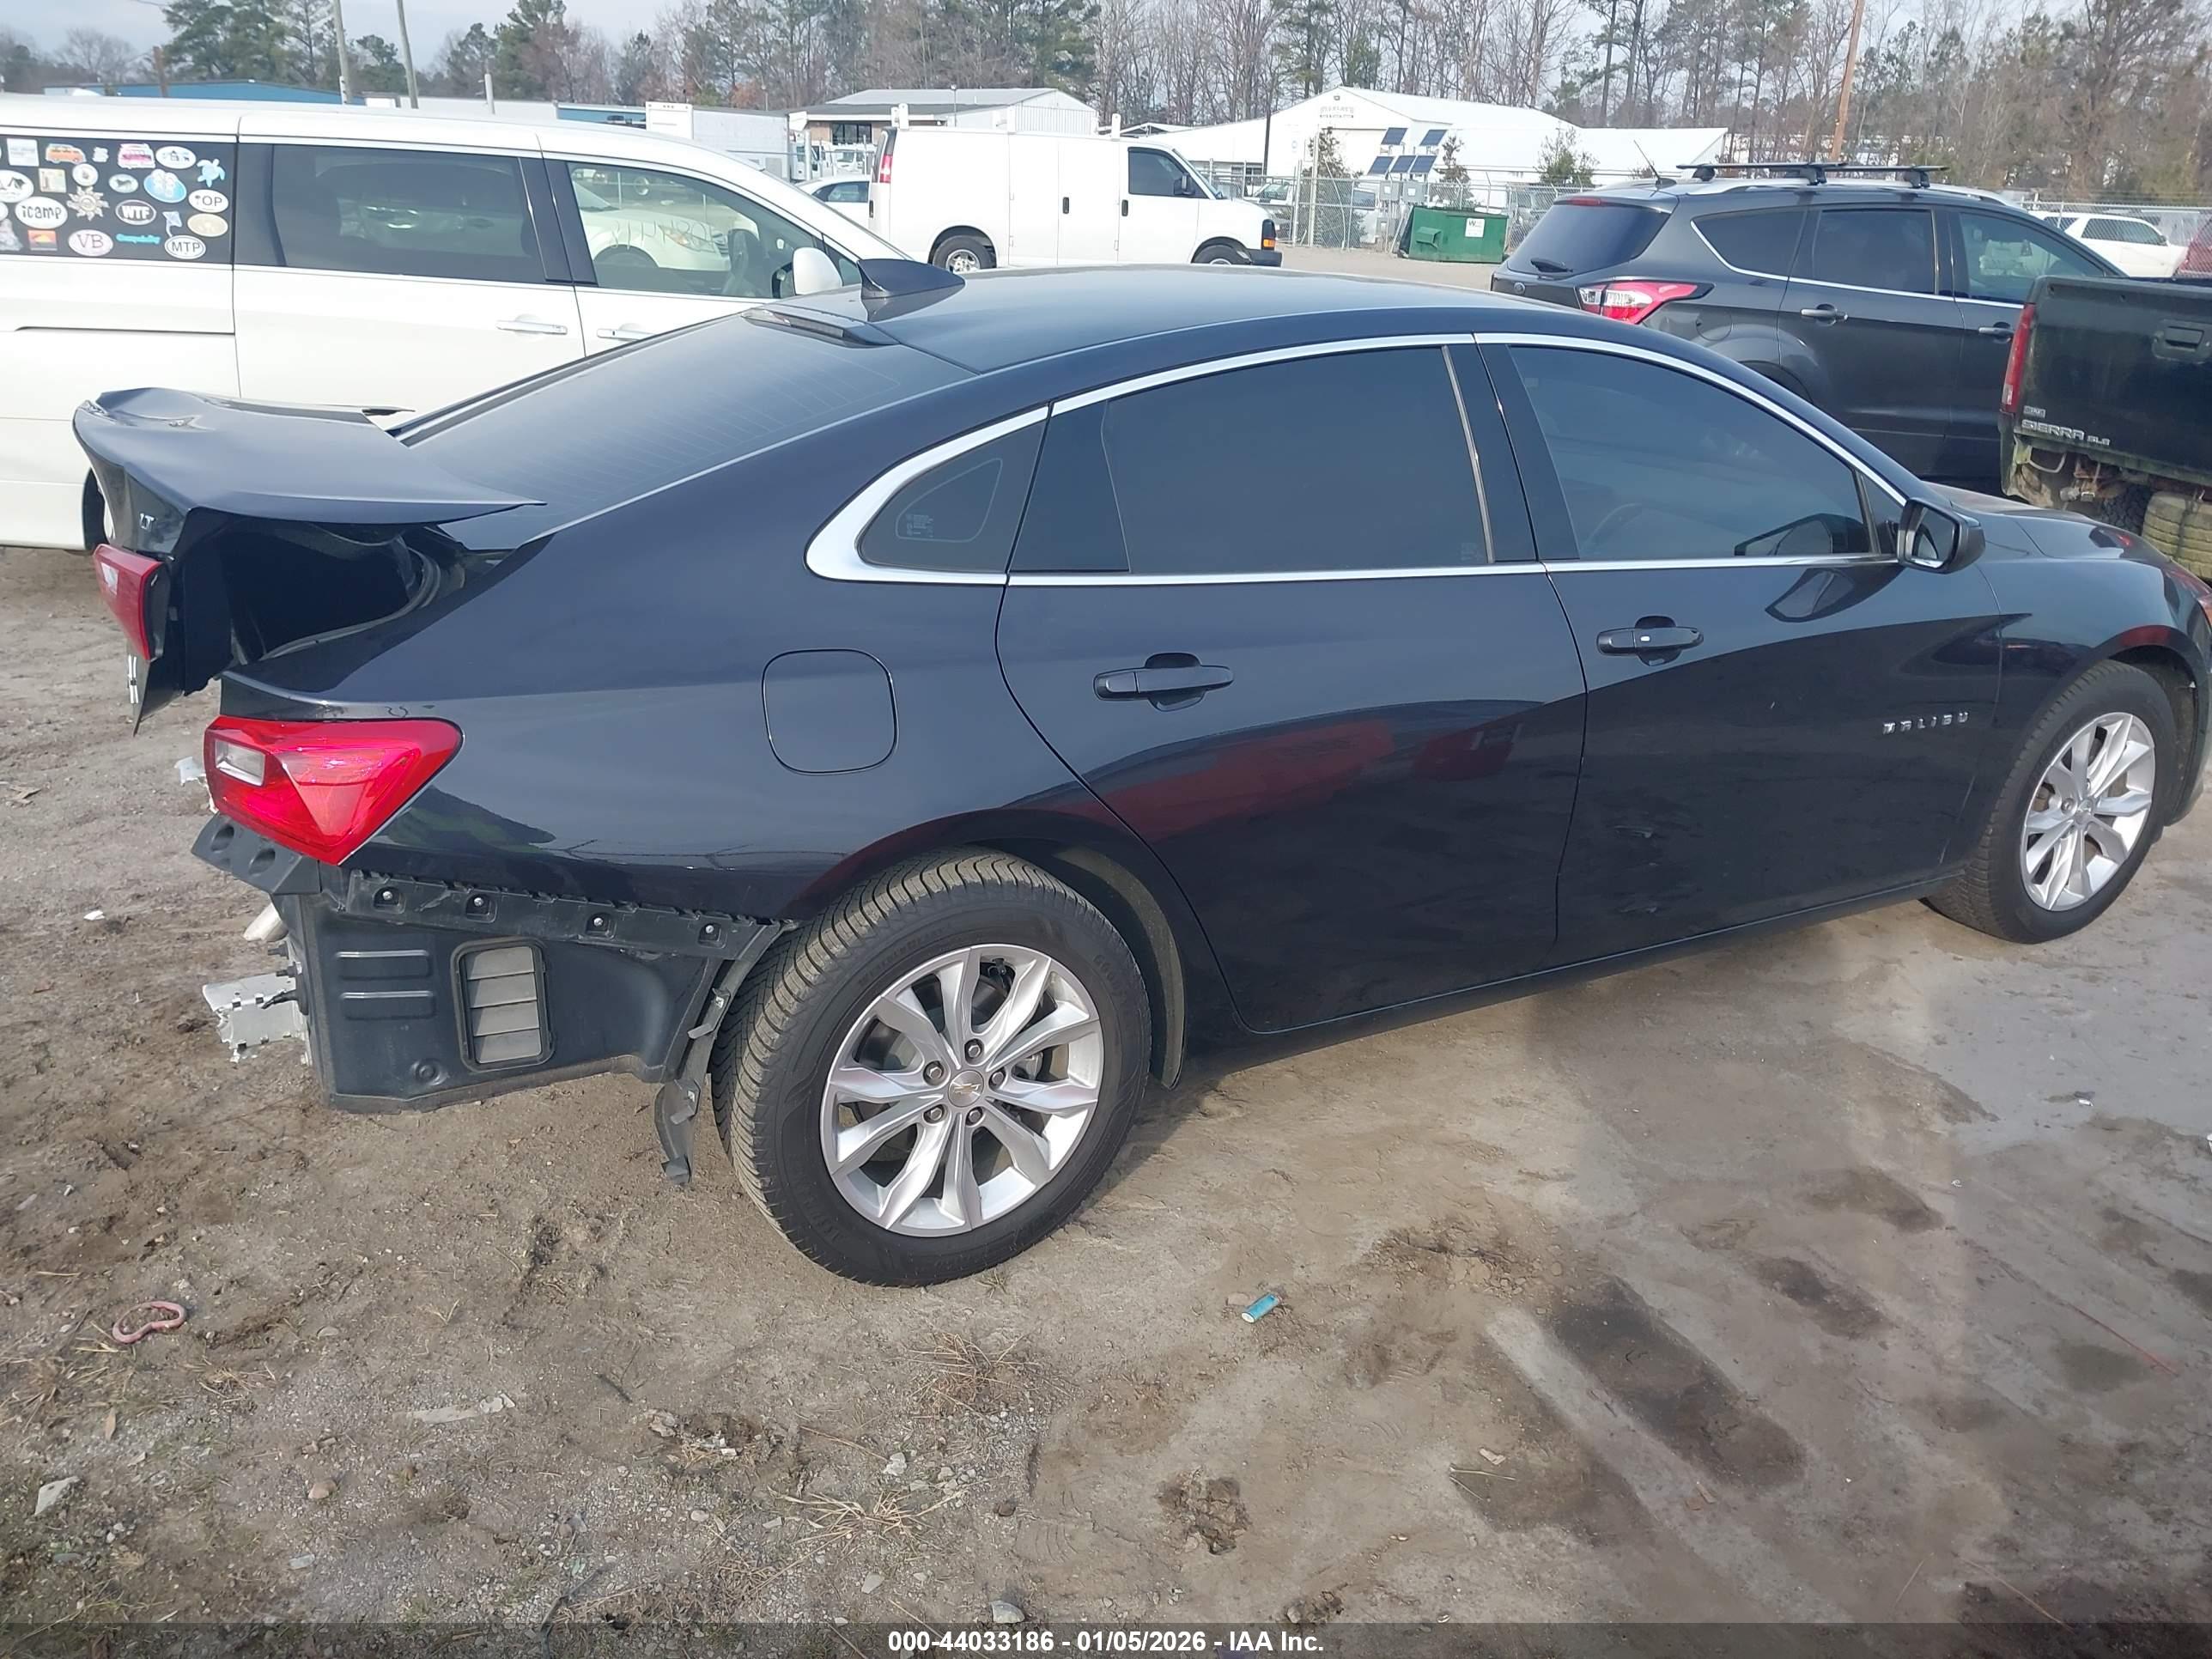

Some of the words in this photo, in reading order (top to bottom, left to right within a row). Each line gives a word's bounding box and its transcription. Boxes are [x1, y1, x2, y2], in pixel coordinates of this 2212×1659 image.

[21, 205, 62, 219] icamp
[122, 205, 149, 219] WTF
[77, 234, 104, 248] VB
[172, 241, 201, 252] MTP
[2022, 419, 2085, 440] SIERRA
[140, 513, 155, 532] LT
[1883, 712, 1968, 734] MALIBU
